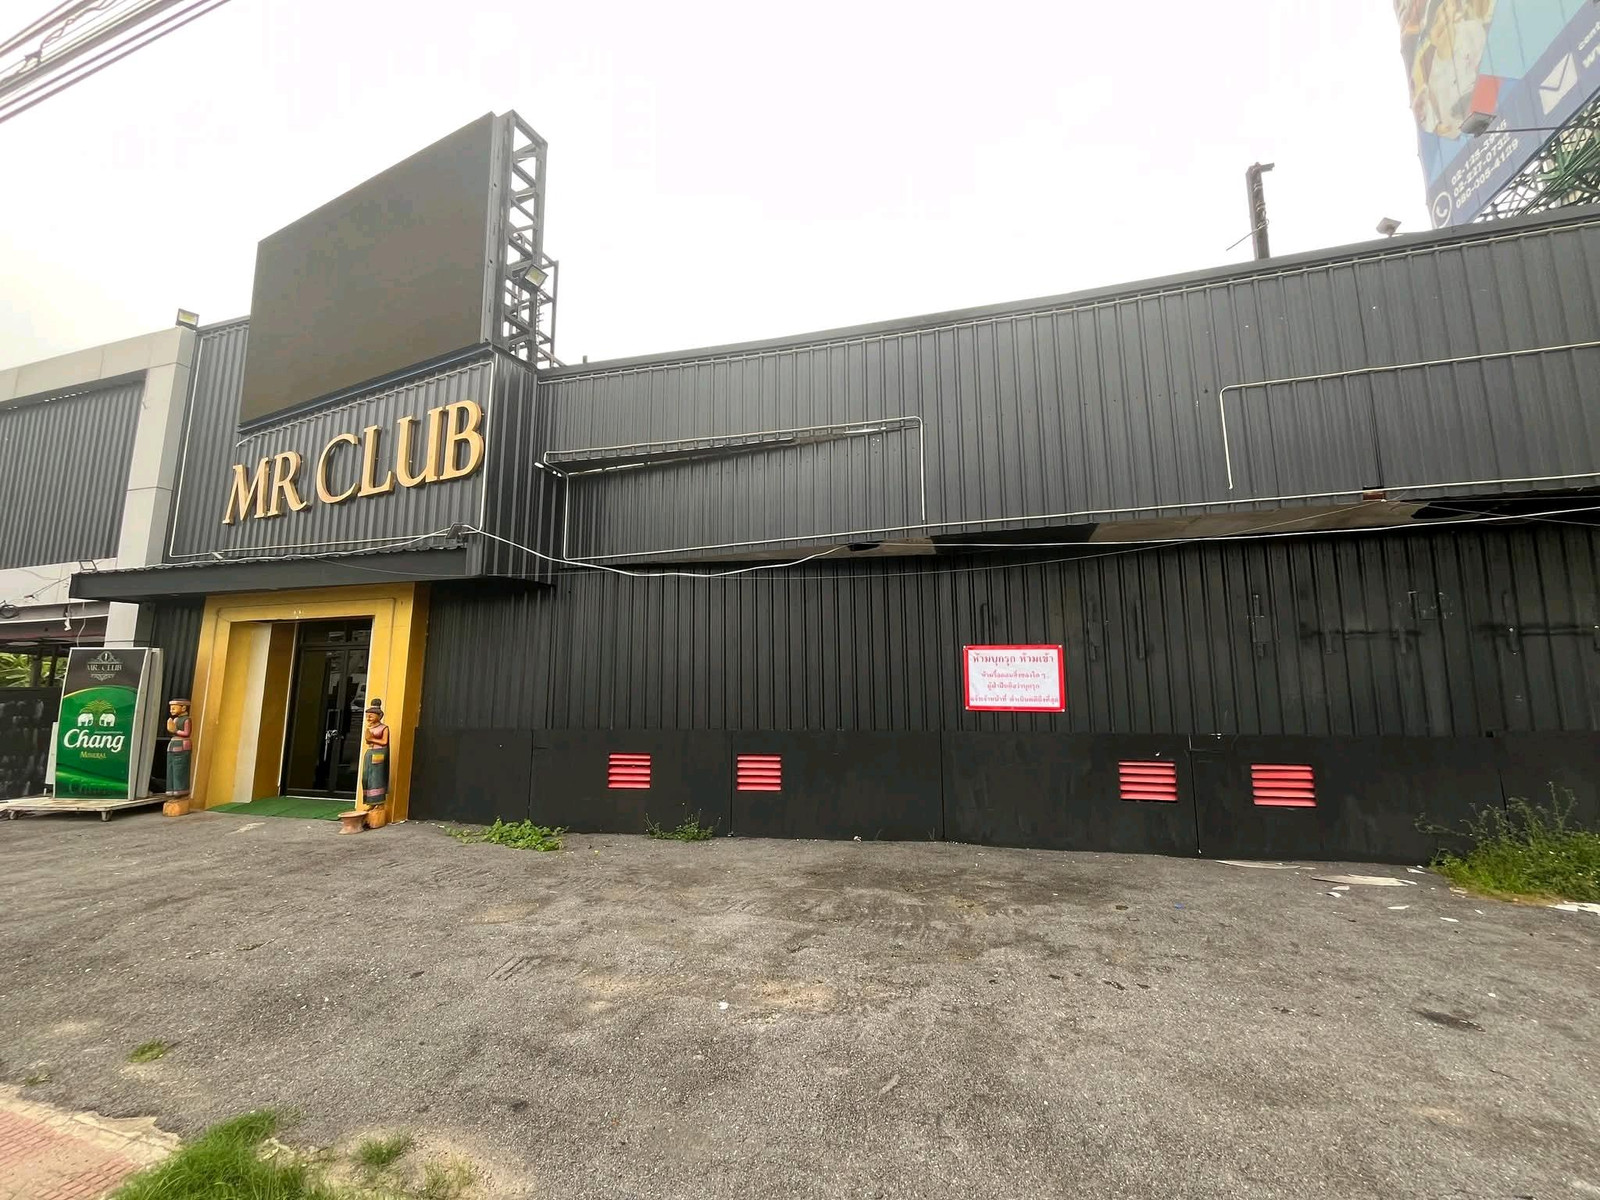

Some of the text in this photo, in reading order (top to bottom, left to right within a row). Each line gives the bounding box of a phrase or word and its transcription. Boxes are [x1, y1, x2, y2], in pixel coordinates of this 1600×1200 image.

[222, 400, 484, 525] MR CLUB
[973, 652, 1054, 666] ห้ามบุกรุก ห้ามเข้า
[63, 728, 125, 753] Chang
